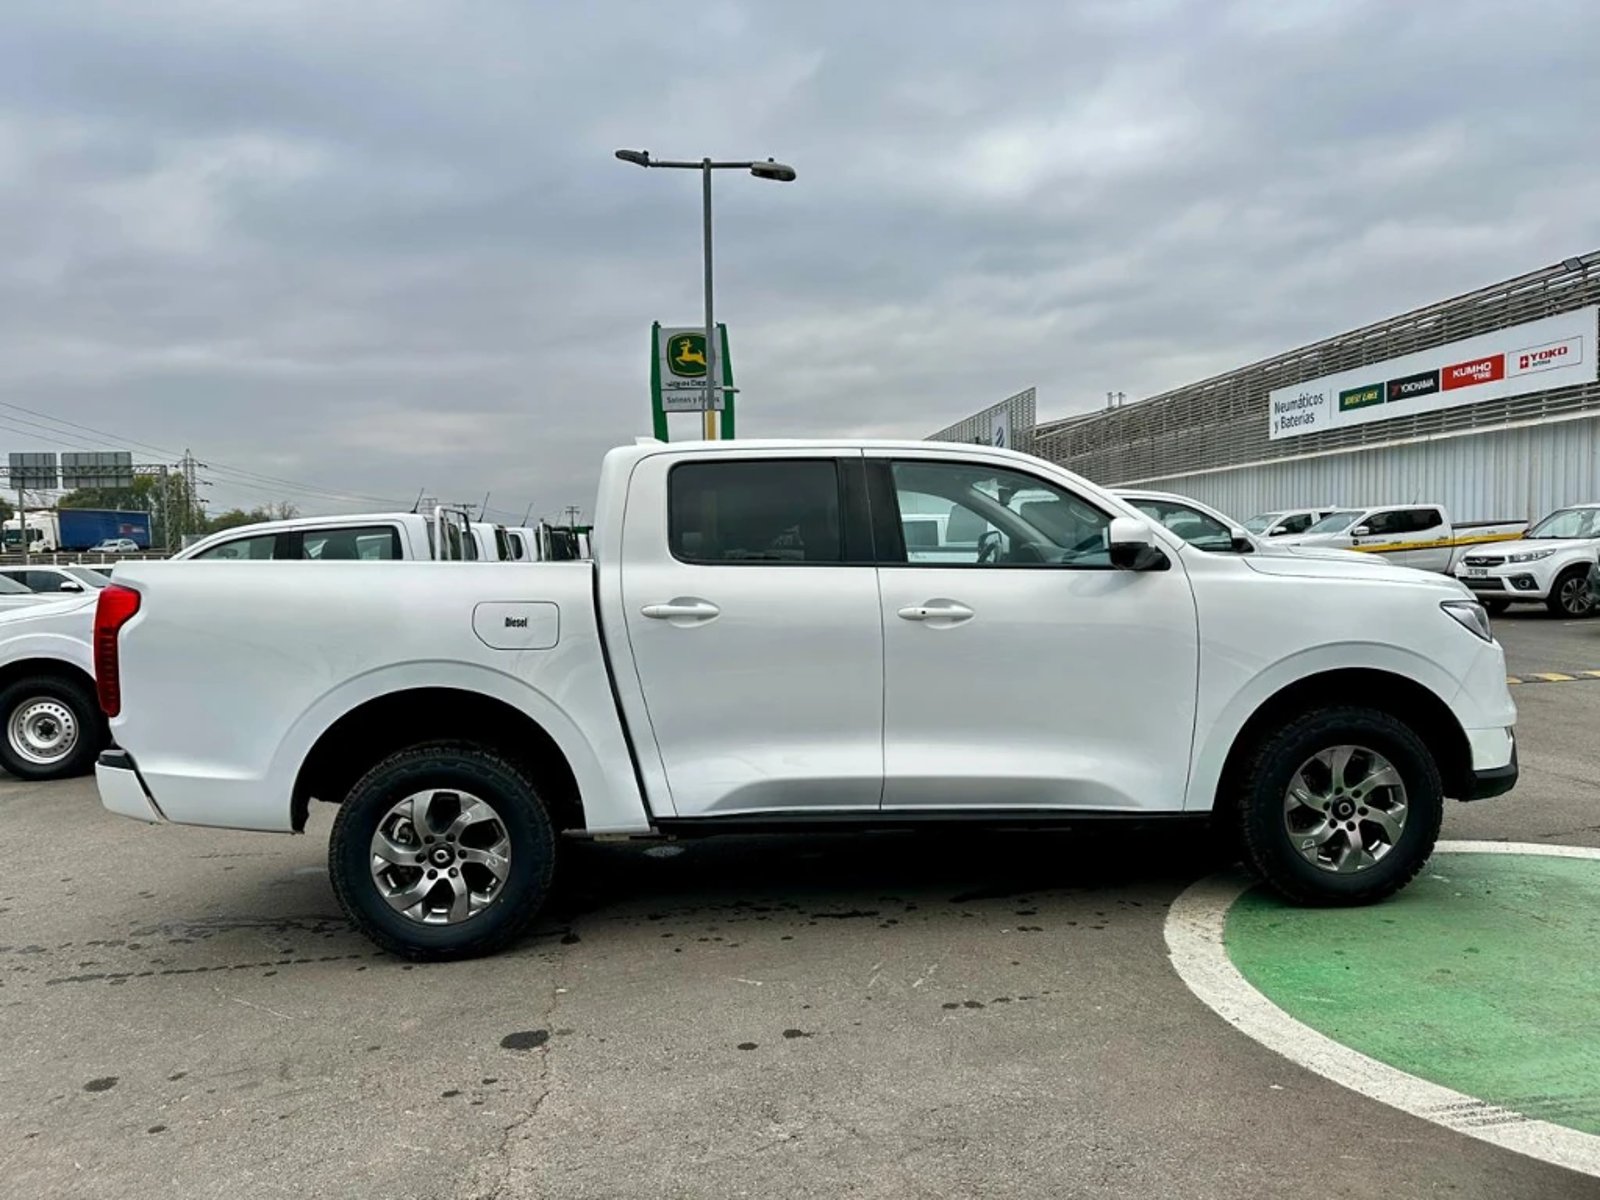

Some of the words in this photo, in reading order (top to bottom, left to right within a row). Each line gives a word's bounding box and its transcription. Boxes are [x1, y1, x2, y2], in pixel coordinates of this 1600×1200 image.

[1530, 346, 1568, 361] YOKO
[1452, 361, 1492, 378] KUMHO
[1274, 393, 1324, 415] Neumáticos
[1280, 409, 1315, 429] Baterías
[505, 616, 527, 628] Diesel
